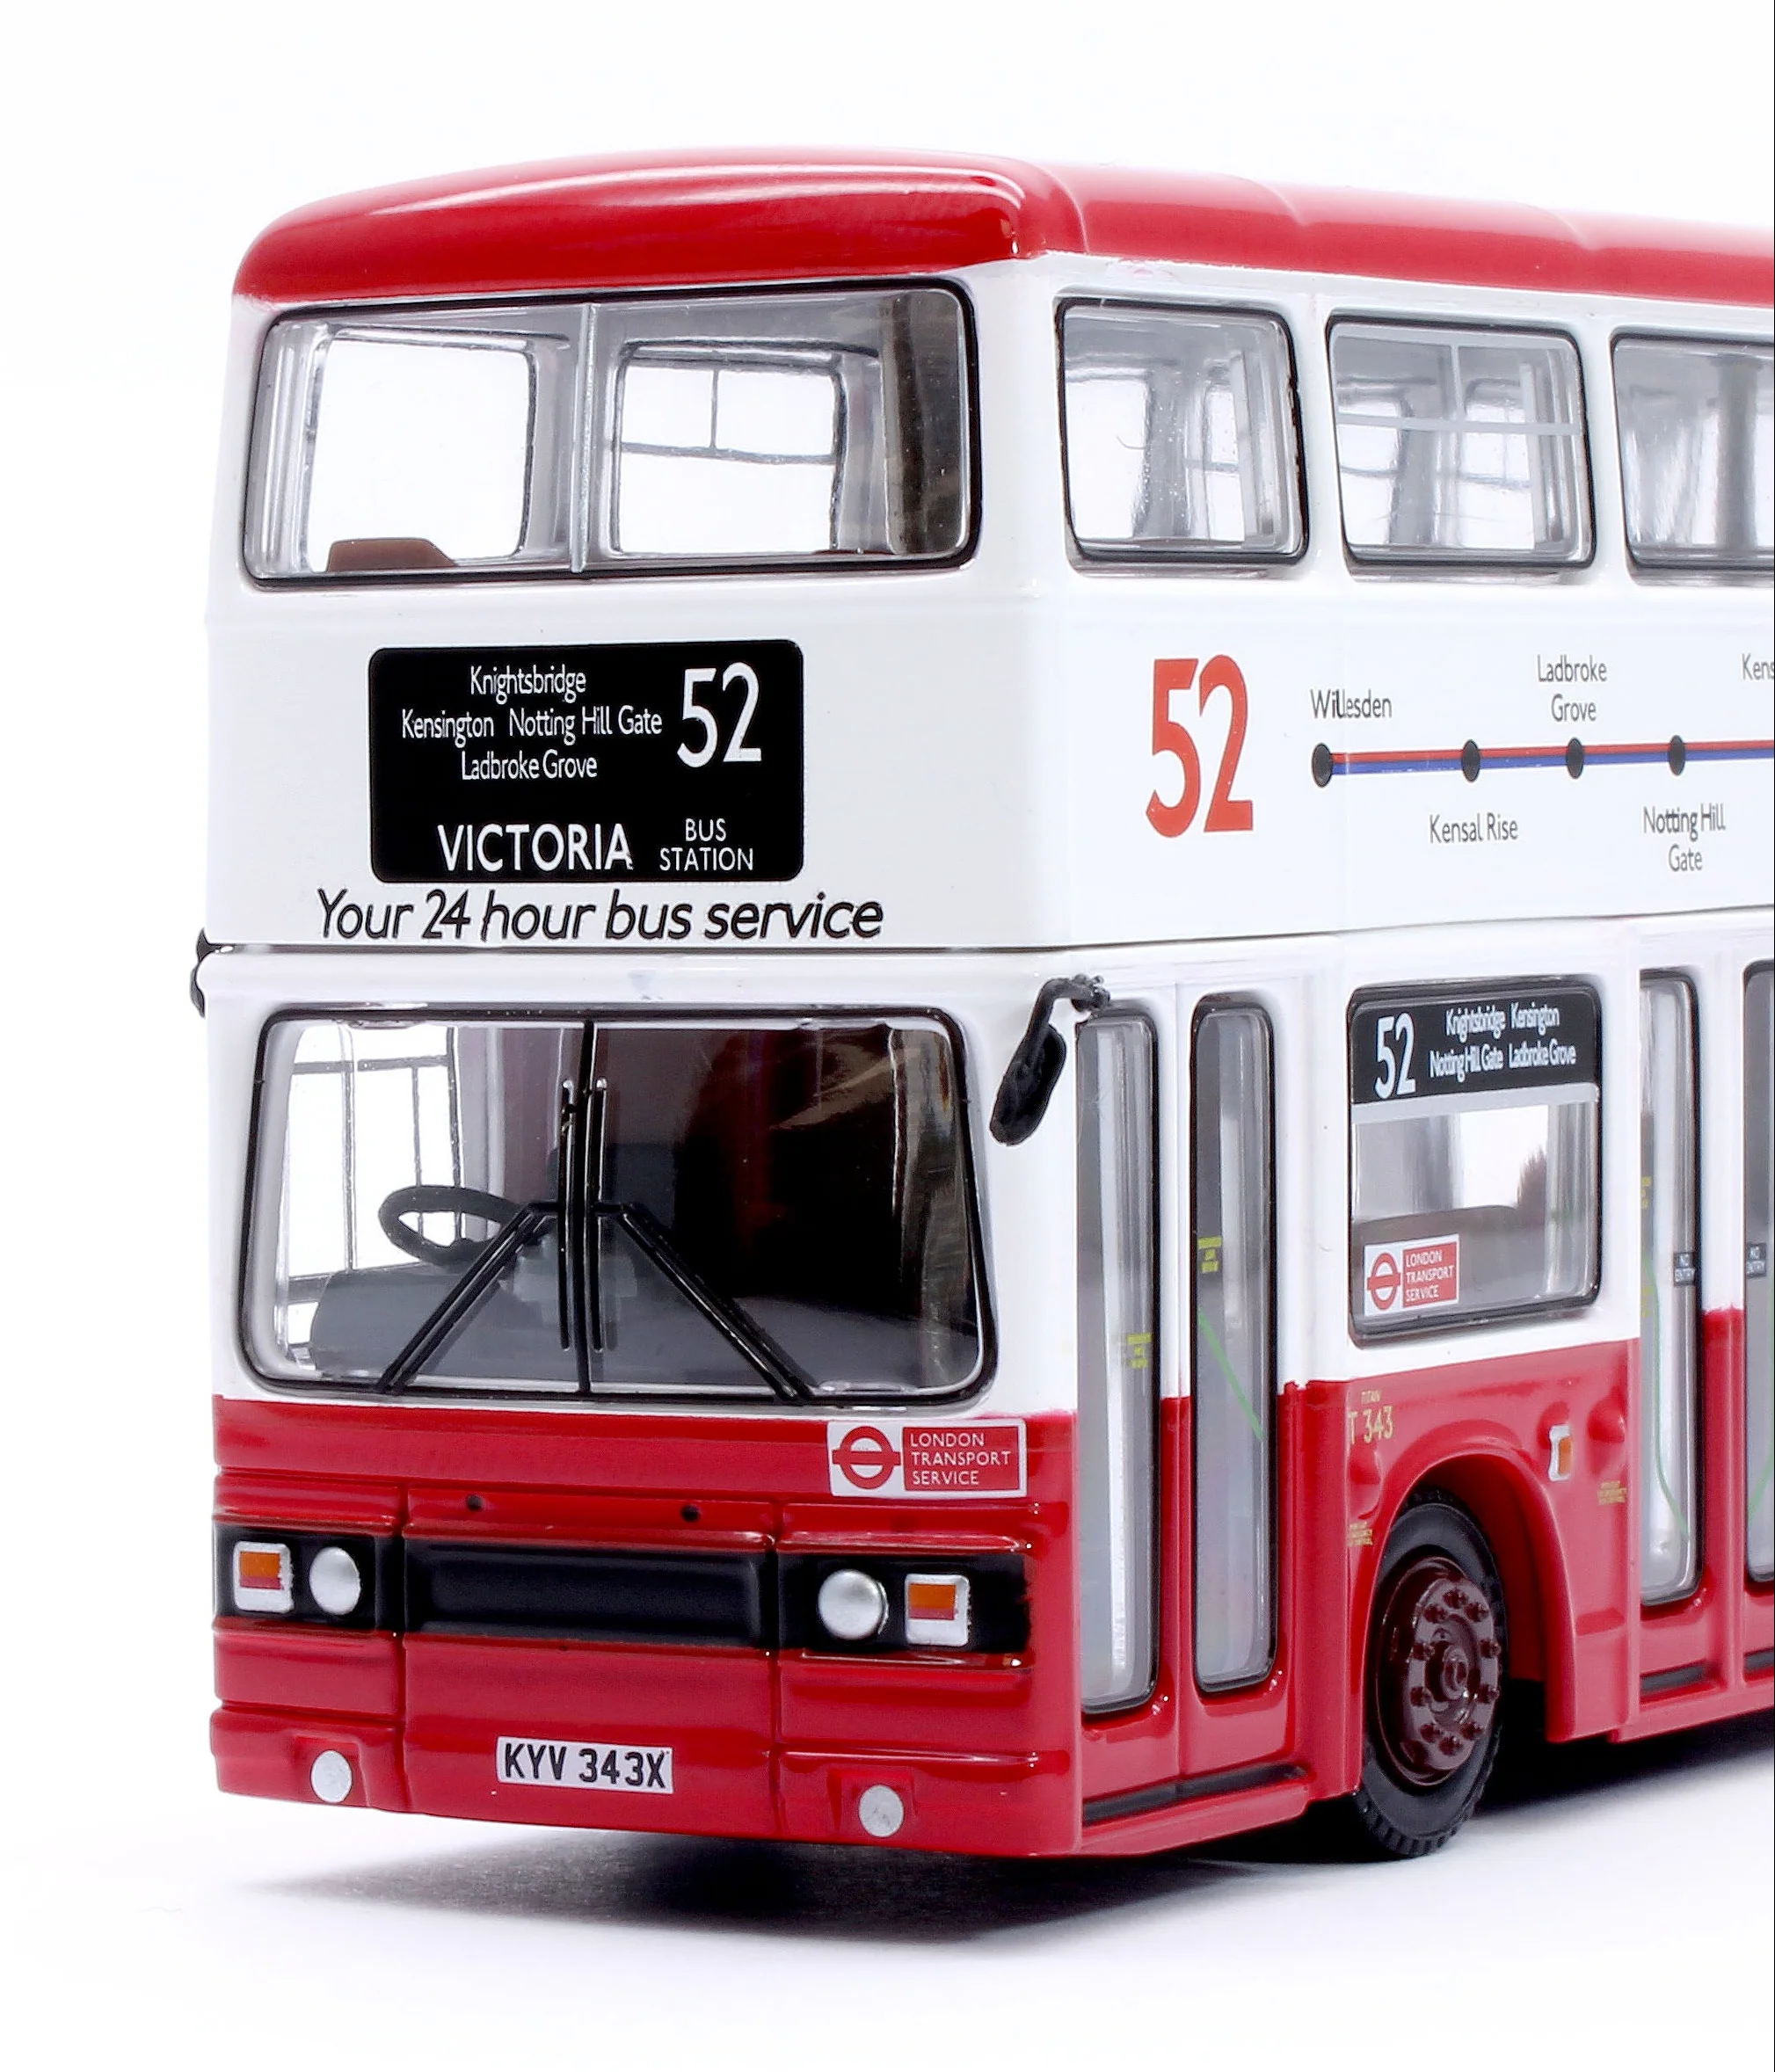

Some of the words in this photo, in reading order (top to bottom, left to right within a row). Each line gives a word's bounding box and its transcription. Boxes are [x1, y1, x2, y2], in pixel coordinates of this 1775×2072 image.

[1536, 653, 1607, 683] Ladbroke
[470, 664, 586, 704] Knightsbridge
[676, 661, 762, 767] 52
[1310, 688, 1393, 719] Willesden
[1551, 692, 1597, 723] Grove
[401, 709, 495, 747] Kensington
[508, 707, 576, 745] Notting
[581, 706, 613, 736] Hill
[617, 706, 662, 735] Gate
[1145, 654, 1254, 838] 52
[461, 751, 539, 781] Ladbroke
[542, 749, 598, 779] Grove
[685, 818, 727, 841] BUS
[1429, 814, 1485, 844] Kensal
[1487, 813, 1518, 841] Rise
[1642, 805, 1699, 840] Notting
[1700, 803, 1727, 832] Hill
[437, 823, 634, 872] VICTORIA
[658, 847, 754, 871] STATION
[1669, 844, 1704, 873] Gate
[316, 887, 414, 939] Your
[421, 889, 471, 940] 24
[480, 889, 597, 942] hour
[605, 888, 691, 939] bus
[703, 891, 884, 941] service
[1445, 1004, 1507, 1043] Knightsbridge
[1509, 1001, 1560, 1036] Kensington
[1374, 1012, 1417, 1099] 52
[1406, 1249, 1443, 1269] LONDON
[1406, 1265, 1454, 1283] TRANSPORT
[1406, 1284, 1440, 1302] SERVICE
[910, 1432, 985, 1447] LONDON
[1349, 1410, 1358, 1445] T
[1363, 1405, 1393, 1443] 343
[911, 1450, 1012, 1466] TRANSPORT
[912, 1470, 979, 1486] SERVICE
[505, 1742, 567, 1781] KYV
[578, 1748, 666, 1788] 343X
